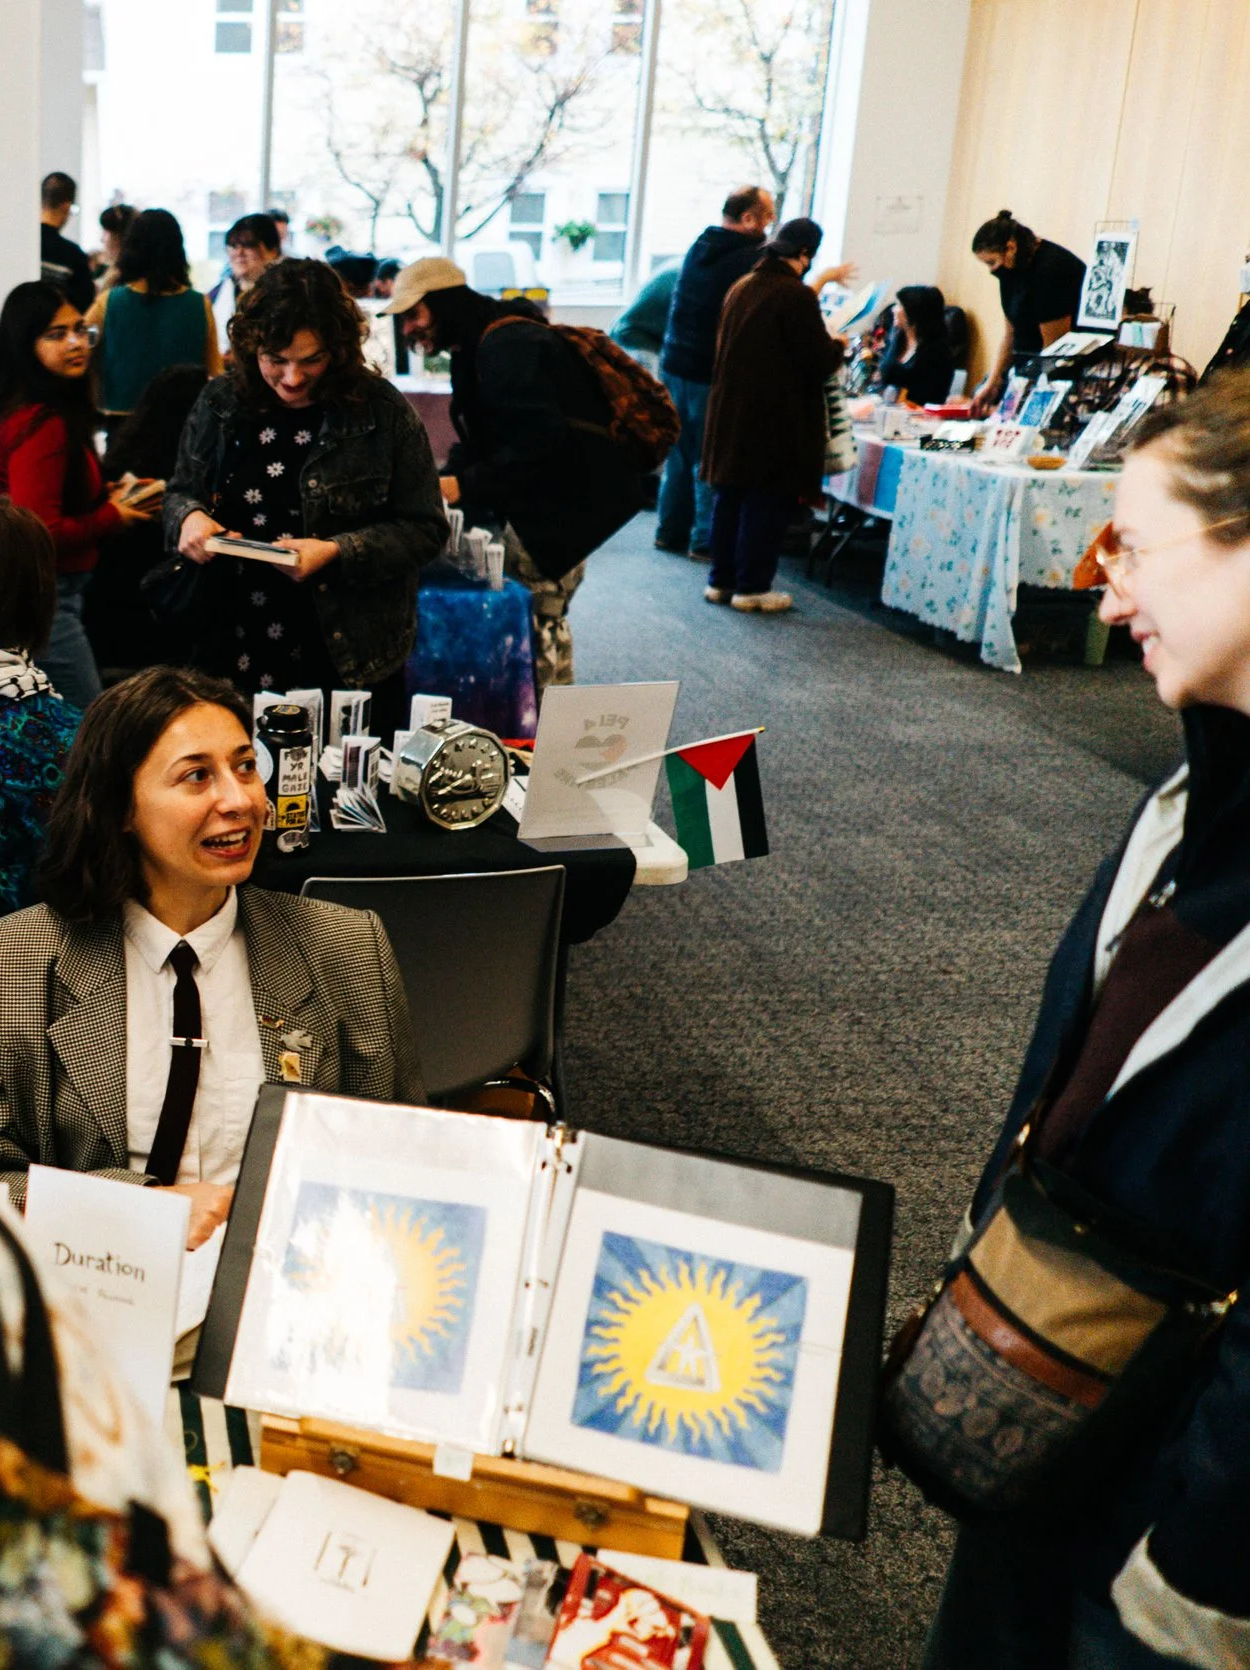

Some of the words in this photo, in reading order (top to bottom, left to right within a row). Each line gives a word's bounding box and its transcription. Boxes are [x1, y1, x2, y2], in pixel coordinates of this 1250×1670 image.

[282, 772, 308, 783] MALE
[282, 783, 308, 793] GAZE
[54, 1241, 145, 1282] Duration
